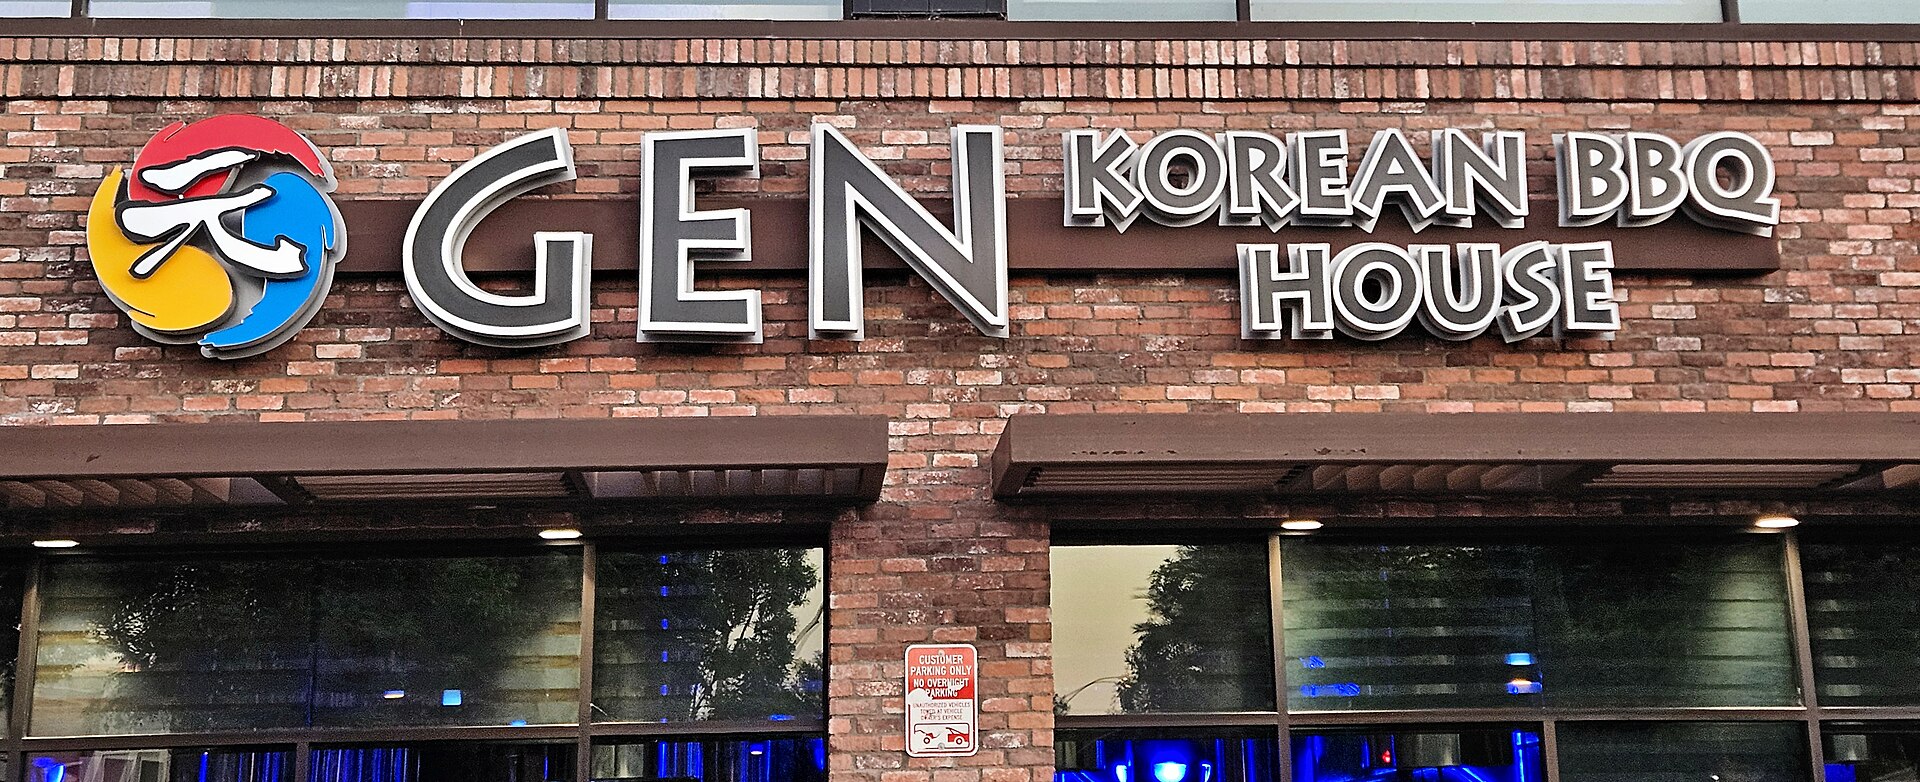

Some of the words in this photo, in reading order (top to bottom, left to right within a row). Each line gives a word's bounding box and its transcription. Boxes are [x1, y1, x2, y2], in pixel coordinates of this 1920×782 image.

[1065, 128, 1528, 230] KOREAN
[1557, 131, 1780, 236] BBQ
[404, 123, 1007, 342] GEN
[1239, 241, 1620, 341] HOUSE
[919, 654, 963, 664] CUSTOMER
[910, 666, 946, 676] PARKING
[950, 666, 972, 676] ONLY
[913, 678, 924, 687] NO
[927, 678, 969, 688] OVERNIGHT
[926, 688, 958, 697] PARKING
